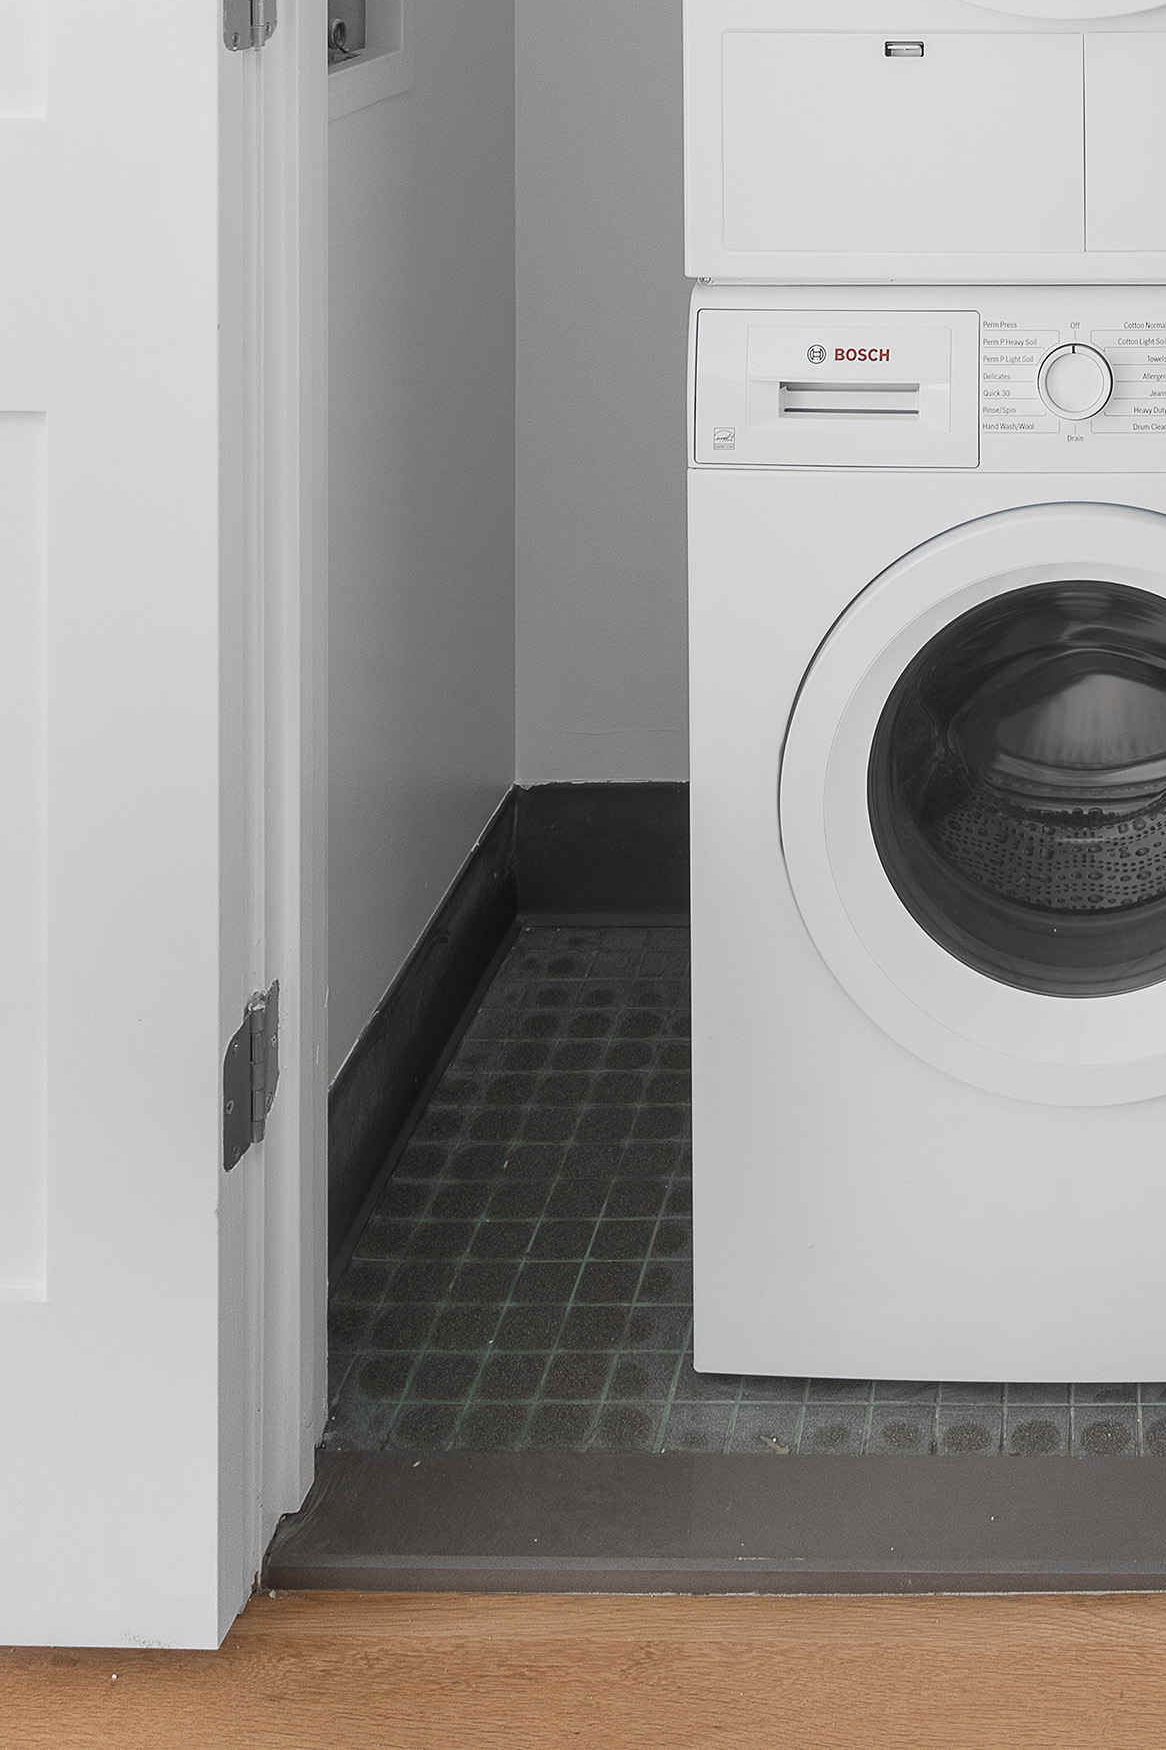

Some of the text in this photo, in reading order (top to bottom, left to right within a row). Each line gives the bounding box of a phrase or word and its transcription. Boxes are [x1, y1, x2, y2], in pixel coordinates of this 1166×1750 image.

[1140, 338, 1154, 346] Light
[835, 349, 889, 361] BOSCH
[1006, 356, 1020, 364] Light
